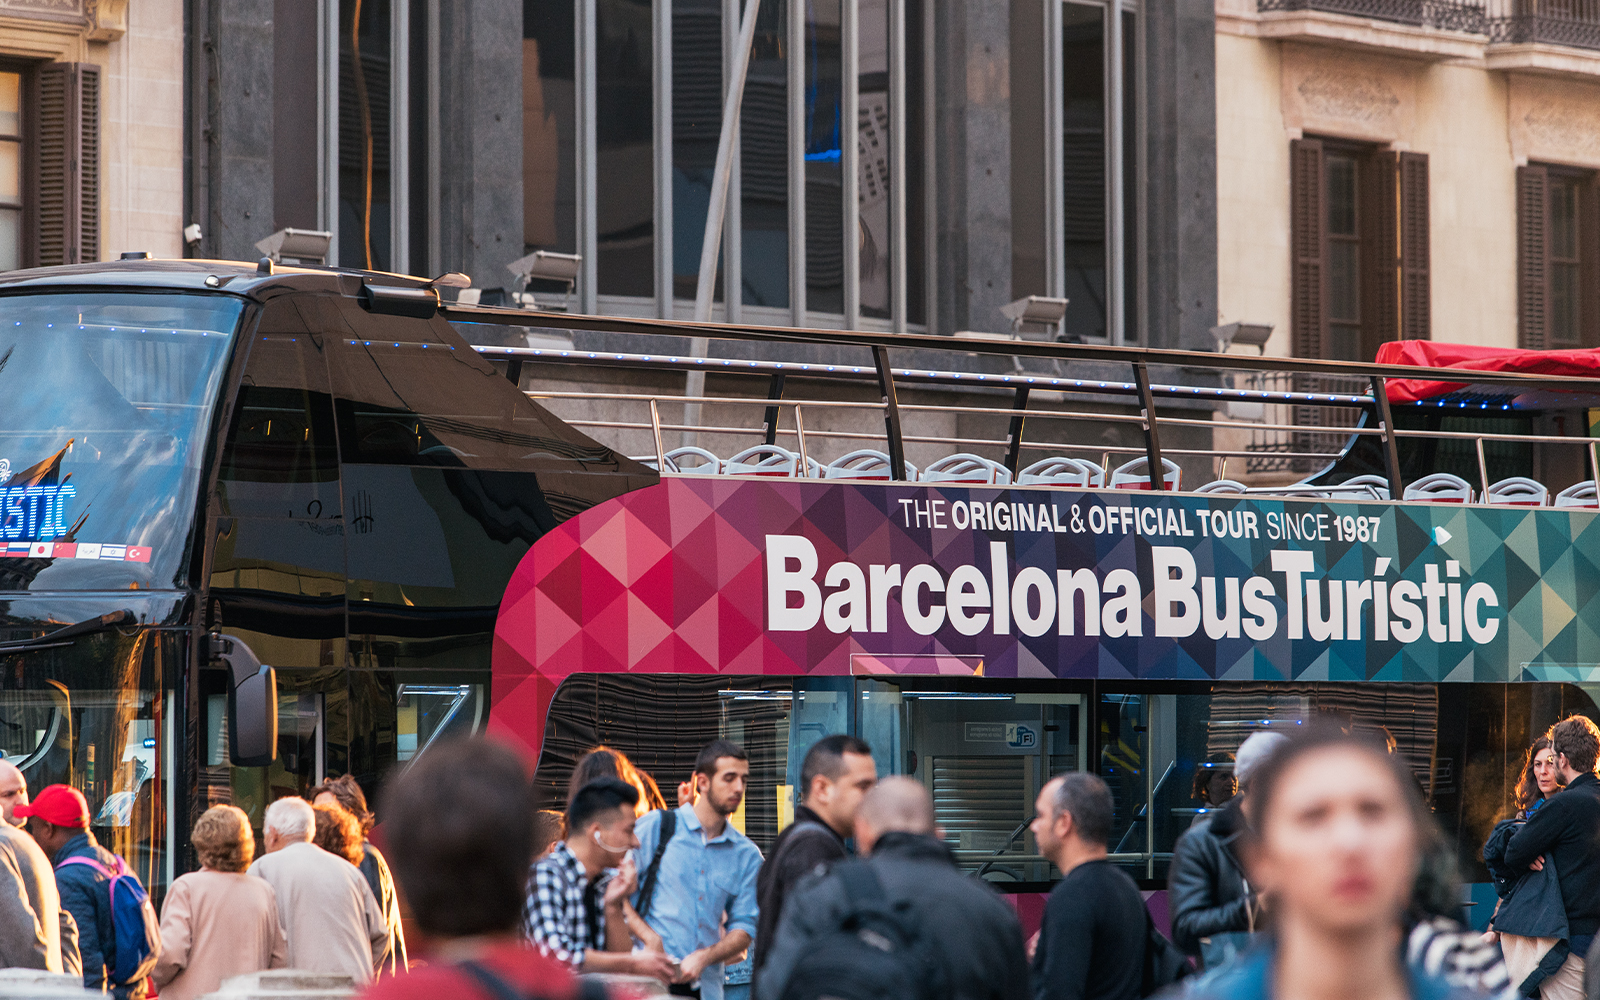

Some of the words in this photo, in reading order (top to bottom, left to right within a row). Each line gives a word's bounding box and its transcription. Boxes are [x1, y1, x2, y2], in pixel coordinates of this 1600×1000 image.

[898, 498, 947, 529] THE
[951, 500, 1067, 533] ORIGINAL
[1070, 503, 1087, 534] &
[1088, 505, 1194, 537] OFFICIAL
[1196, 509, 1259, 539] TOUR
[1266, 511, 1331, 542] SINCE
[1333, 515, 1381, 543] 1987
[765, 534, 1143, 638] Barcelona
